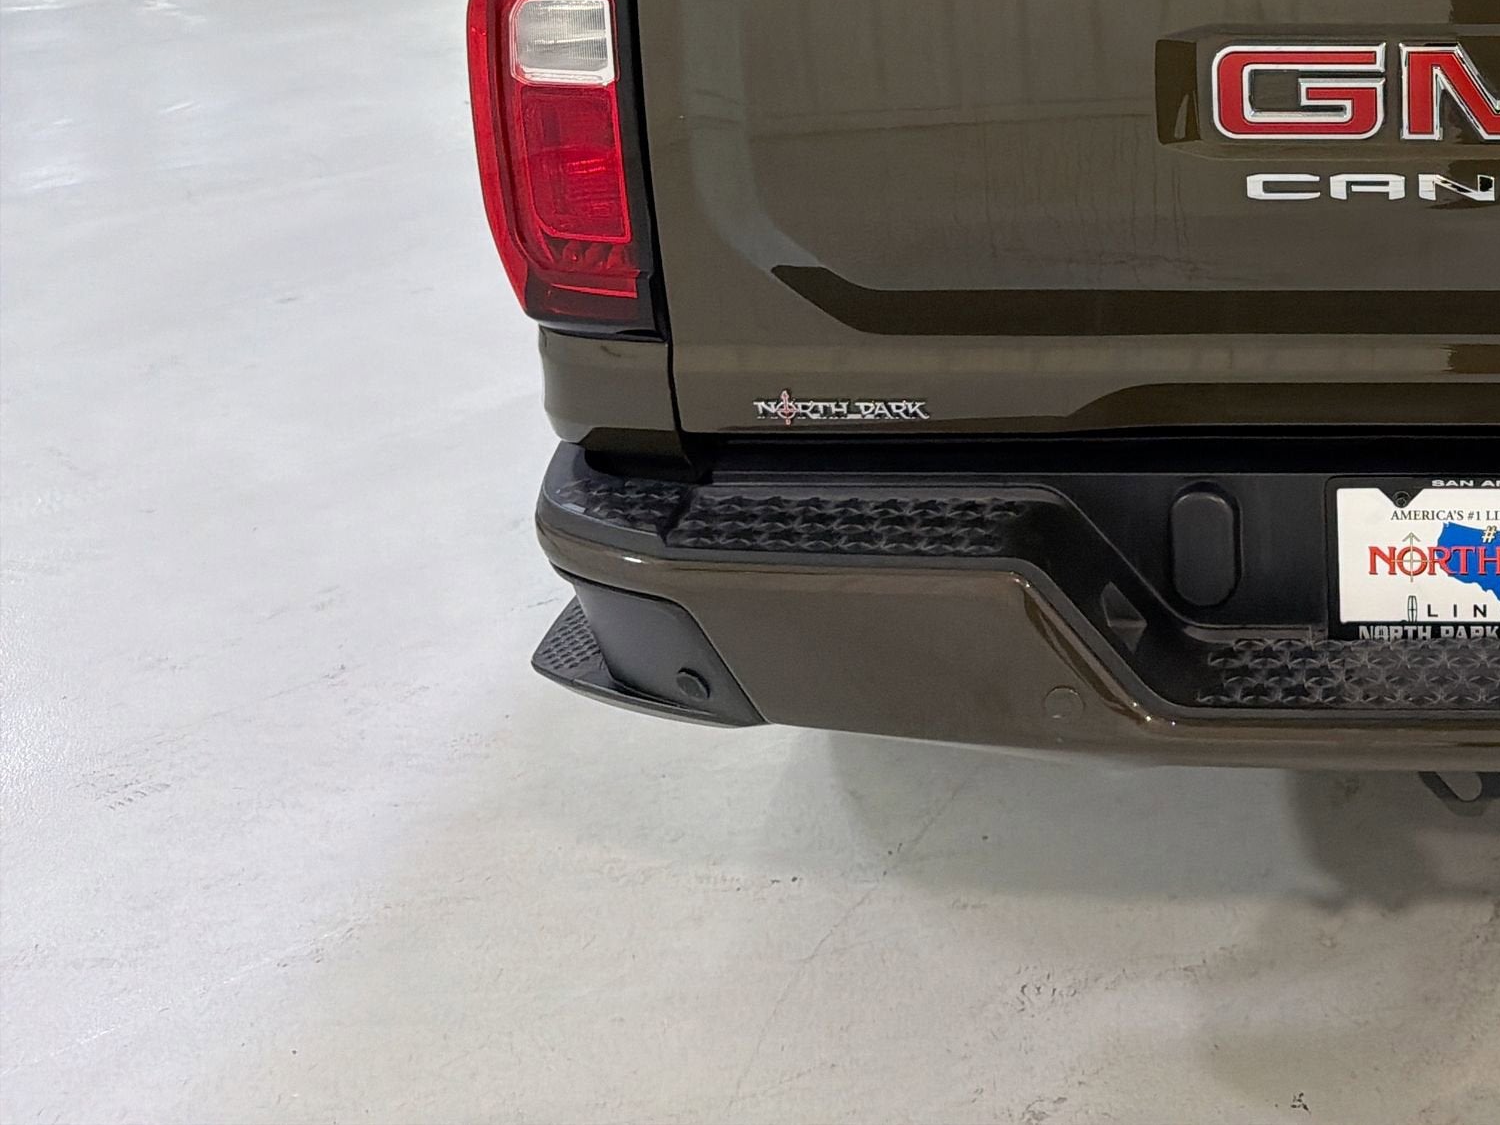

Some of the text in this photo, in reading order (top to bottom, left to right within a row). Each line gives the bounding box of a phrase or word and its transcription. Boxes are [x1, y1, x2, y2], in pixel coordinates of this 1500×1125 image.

[753, 400, 930, 420] NORTH PARK
[1431, 479, 1474, 488] SAN
[1391, 509, 1464, 522] AMERICA'S
[1467, 510, 1481, 521] #1
[1358, 625, 1432, 641] NORTH
[1440, 626, 1499, 640] PARK
